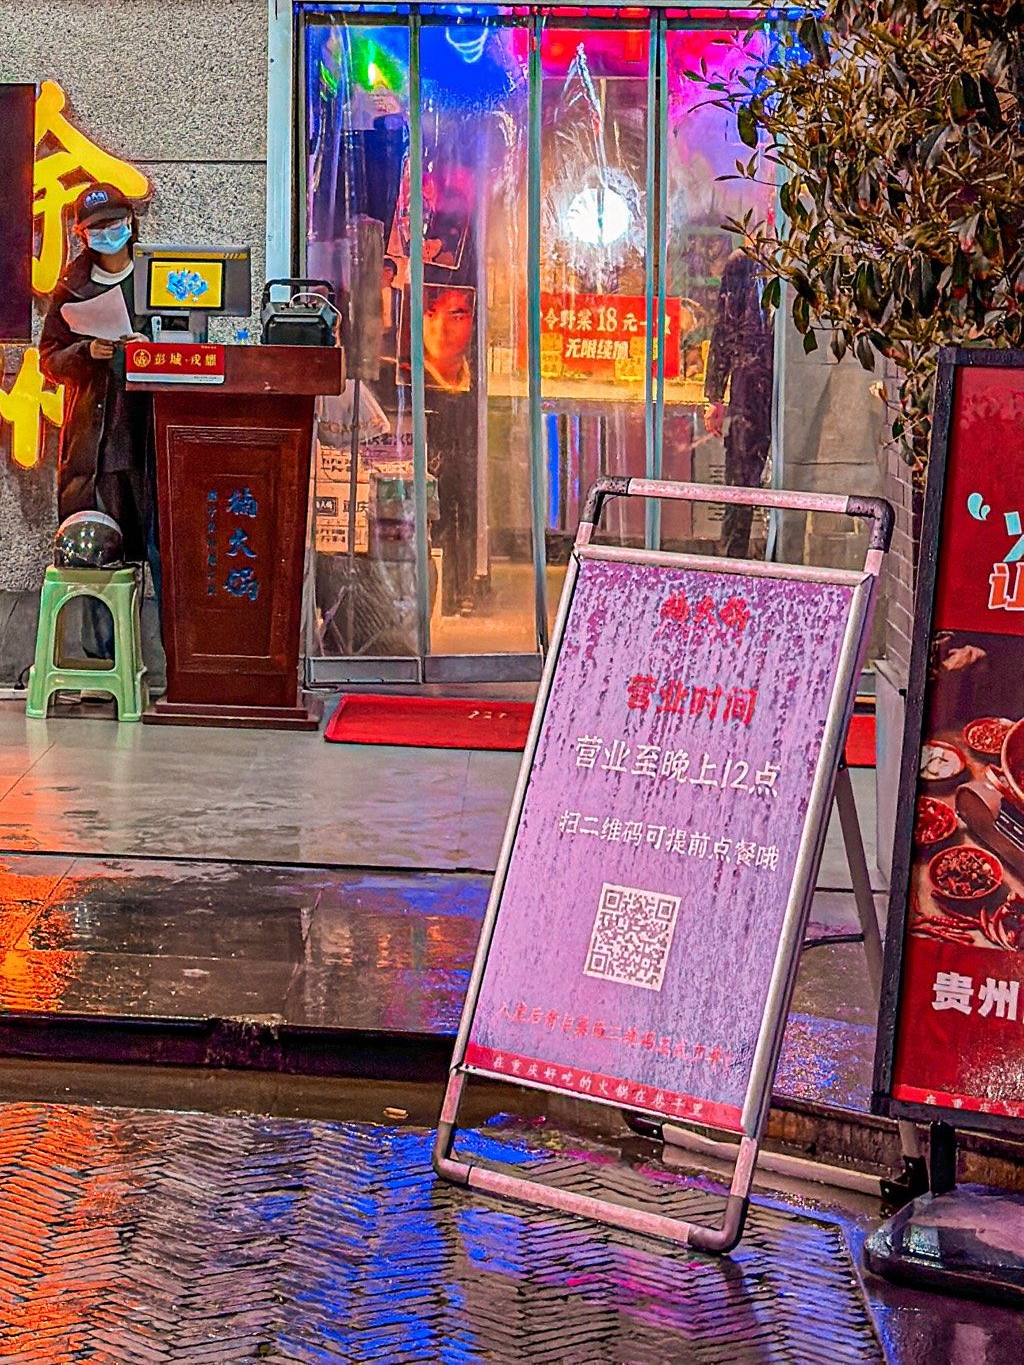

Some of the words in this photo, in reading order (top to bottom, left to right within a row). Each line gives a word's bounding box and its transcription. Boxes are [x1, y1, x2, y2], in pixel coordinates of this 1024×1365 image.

[626, 674, 758, 726] 营业时间
[575, 734, 781, 797] 营业至晚上12点
[559, 809, 779, 872] 扫二维码可提前点餐哦
